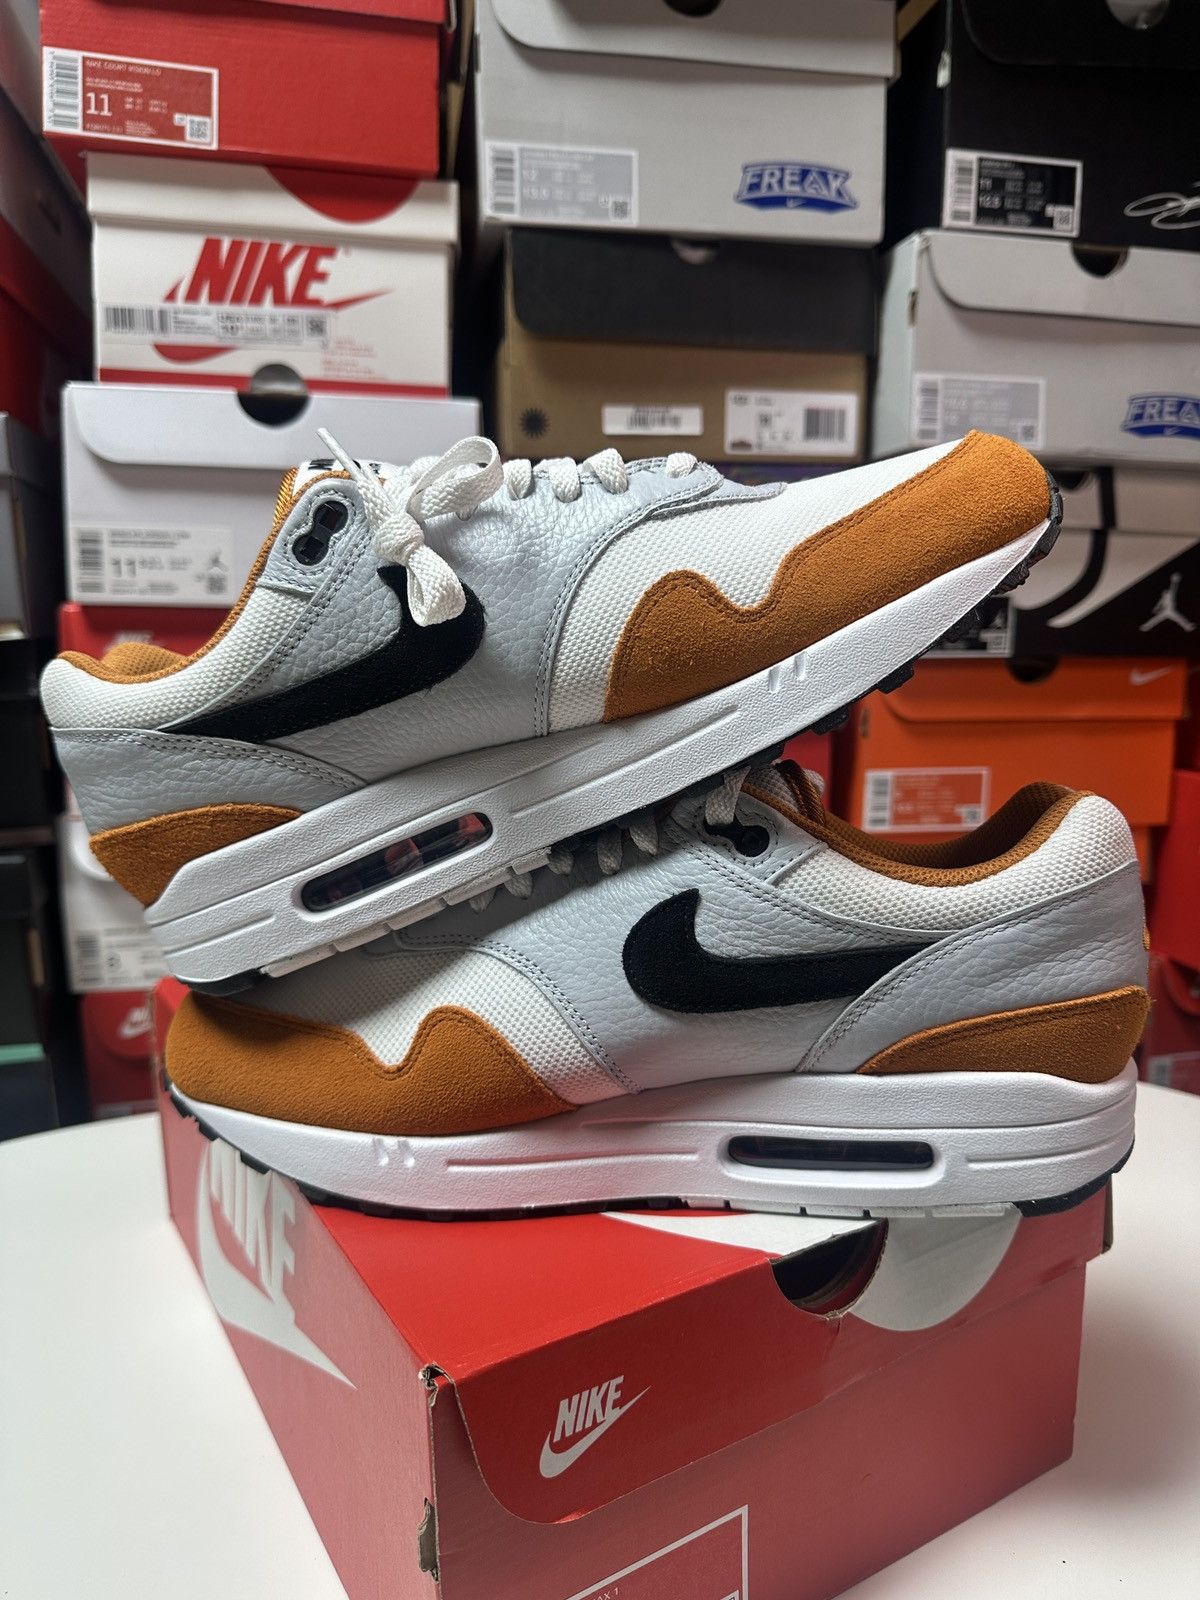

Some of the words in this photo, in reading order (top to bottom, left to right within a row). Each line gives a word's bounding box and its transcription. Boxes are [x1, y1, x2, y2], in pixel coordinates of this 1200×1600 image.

[86, 92, 112, 117] 11
[741, 164, 854, 206] FREAK
[183, 237, 339, 306] NIKE
[1126, 397, 1200, 425] FREA
[111, 557, 137, 578] 11
[210, 1137, 296, 1304] NIKE
[553, 1375, 625, 1443] NIKE
